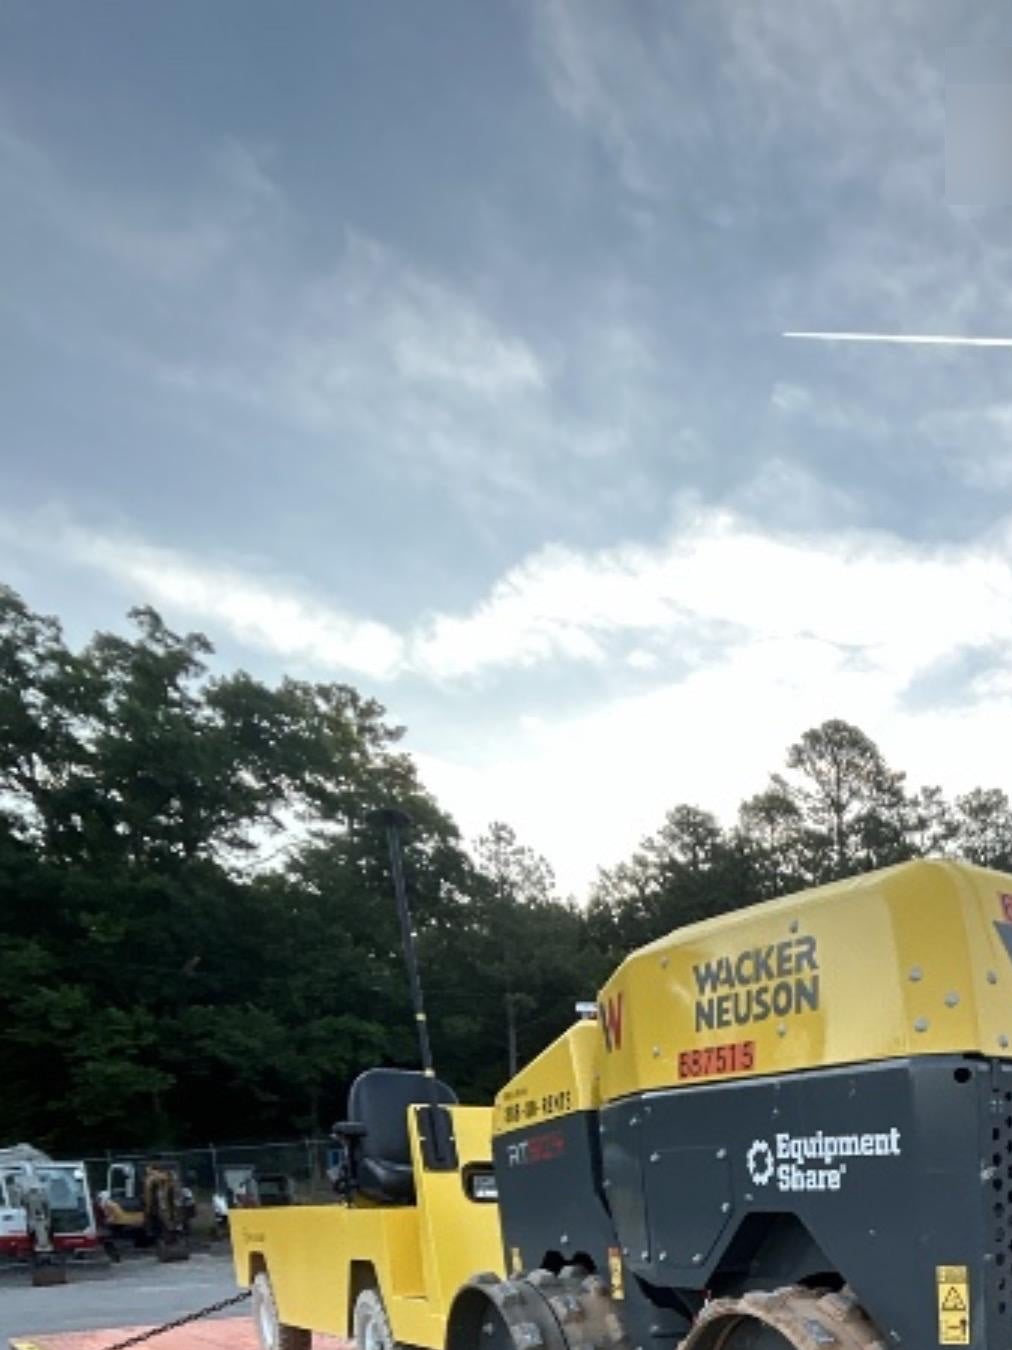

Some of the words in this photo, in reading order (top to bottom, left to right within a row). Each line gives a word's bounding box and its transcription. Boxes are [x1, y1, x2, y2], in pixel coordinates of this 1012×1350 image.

[692, 934, 820, 996] WACKER
[694, 974, 820, 1033] NEUSON
[775, 1126, 902, 1165] Equipment
